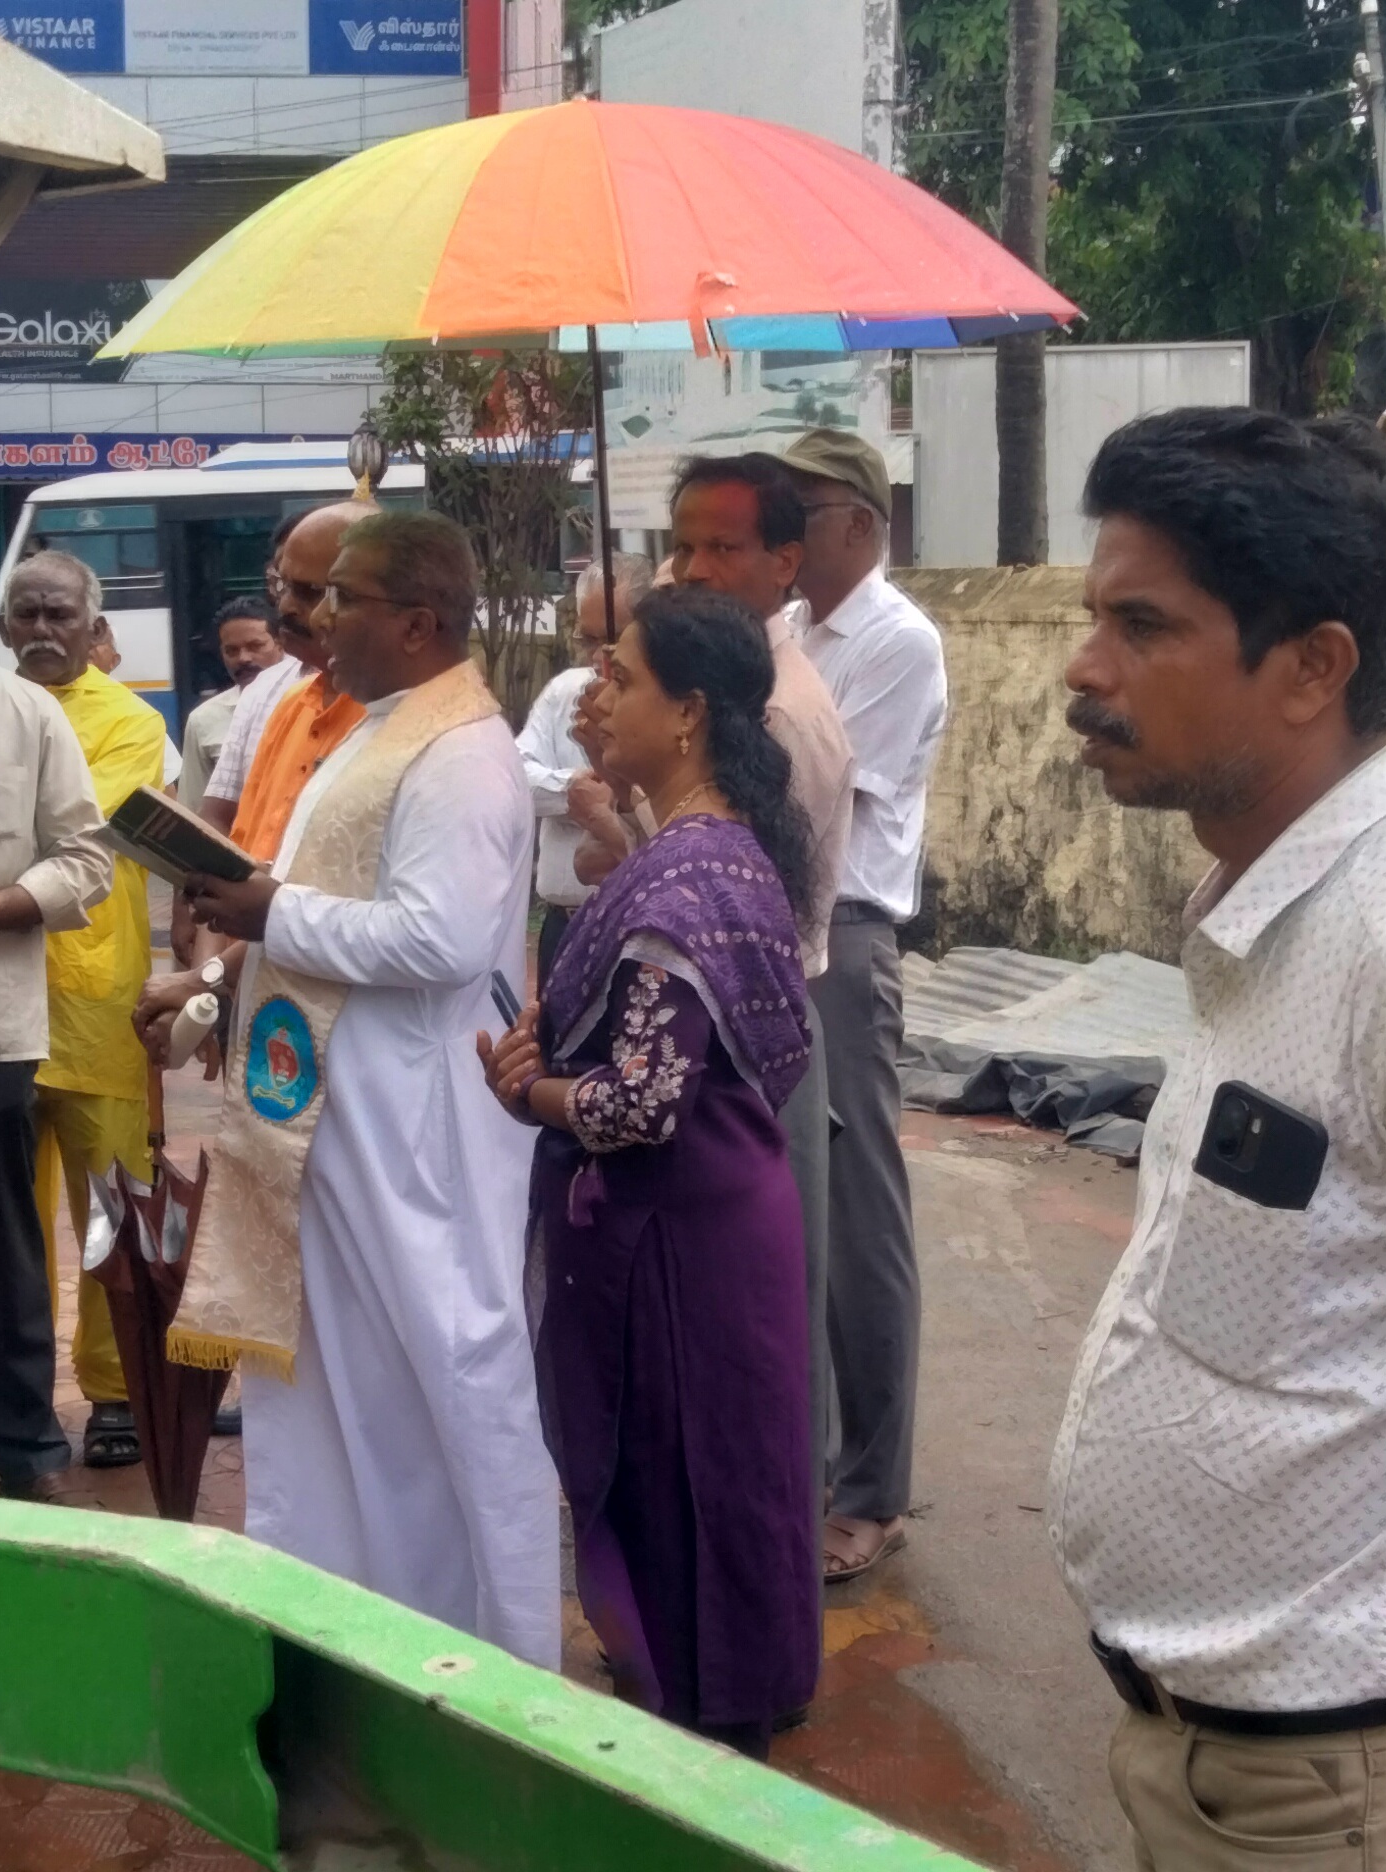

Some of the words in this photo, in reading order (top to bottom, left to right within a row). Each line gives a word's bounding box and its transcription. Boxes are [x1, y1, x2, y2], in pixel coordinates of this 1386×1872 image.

[11, 17, 95, 35] VISTAAR
[378, 17, 459, 38] விஸ்தார்
[16, 37, 95, 49] FINANCE
[27, 350, 79, 358] INSURANCE
